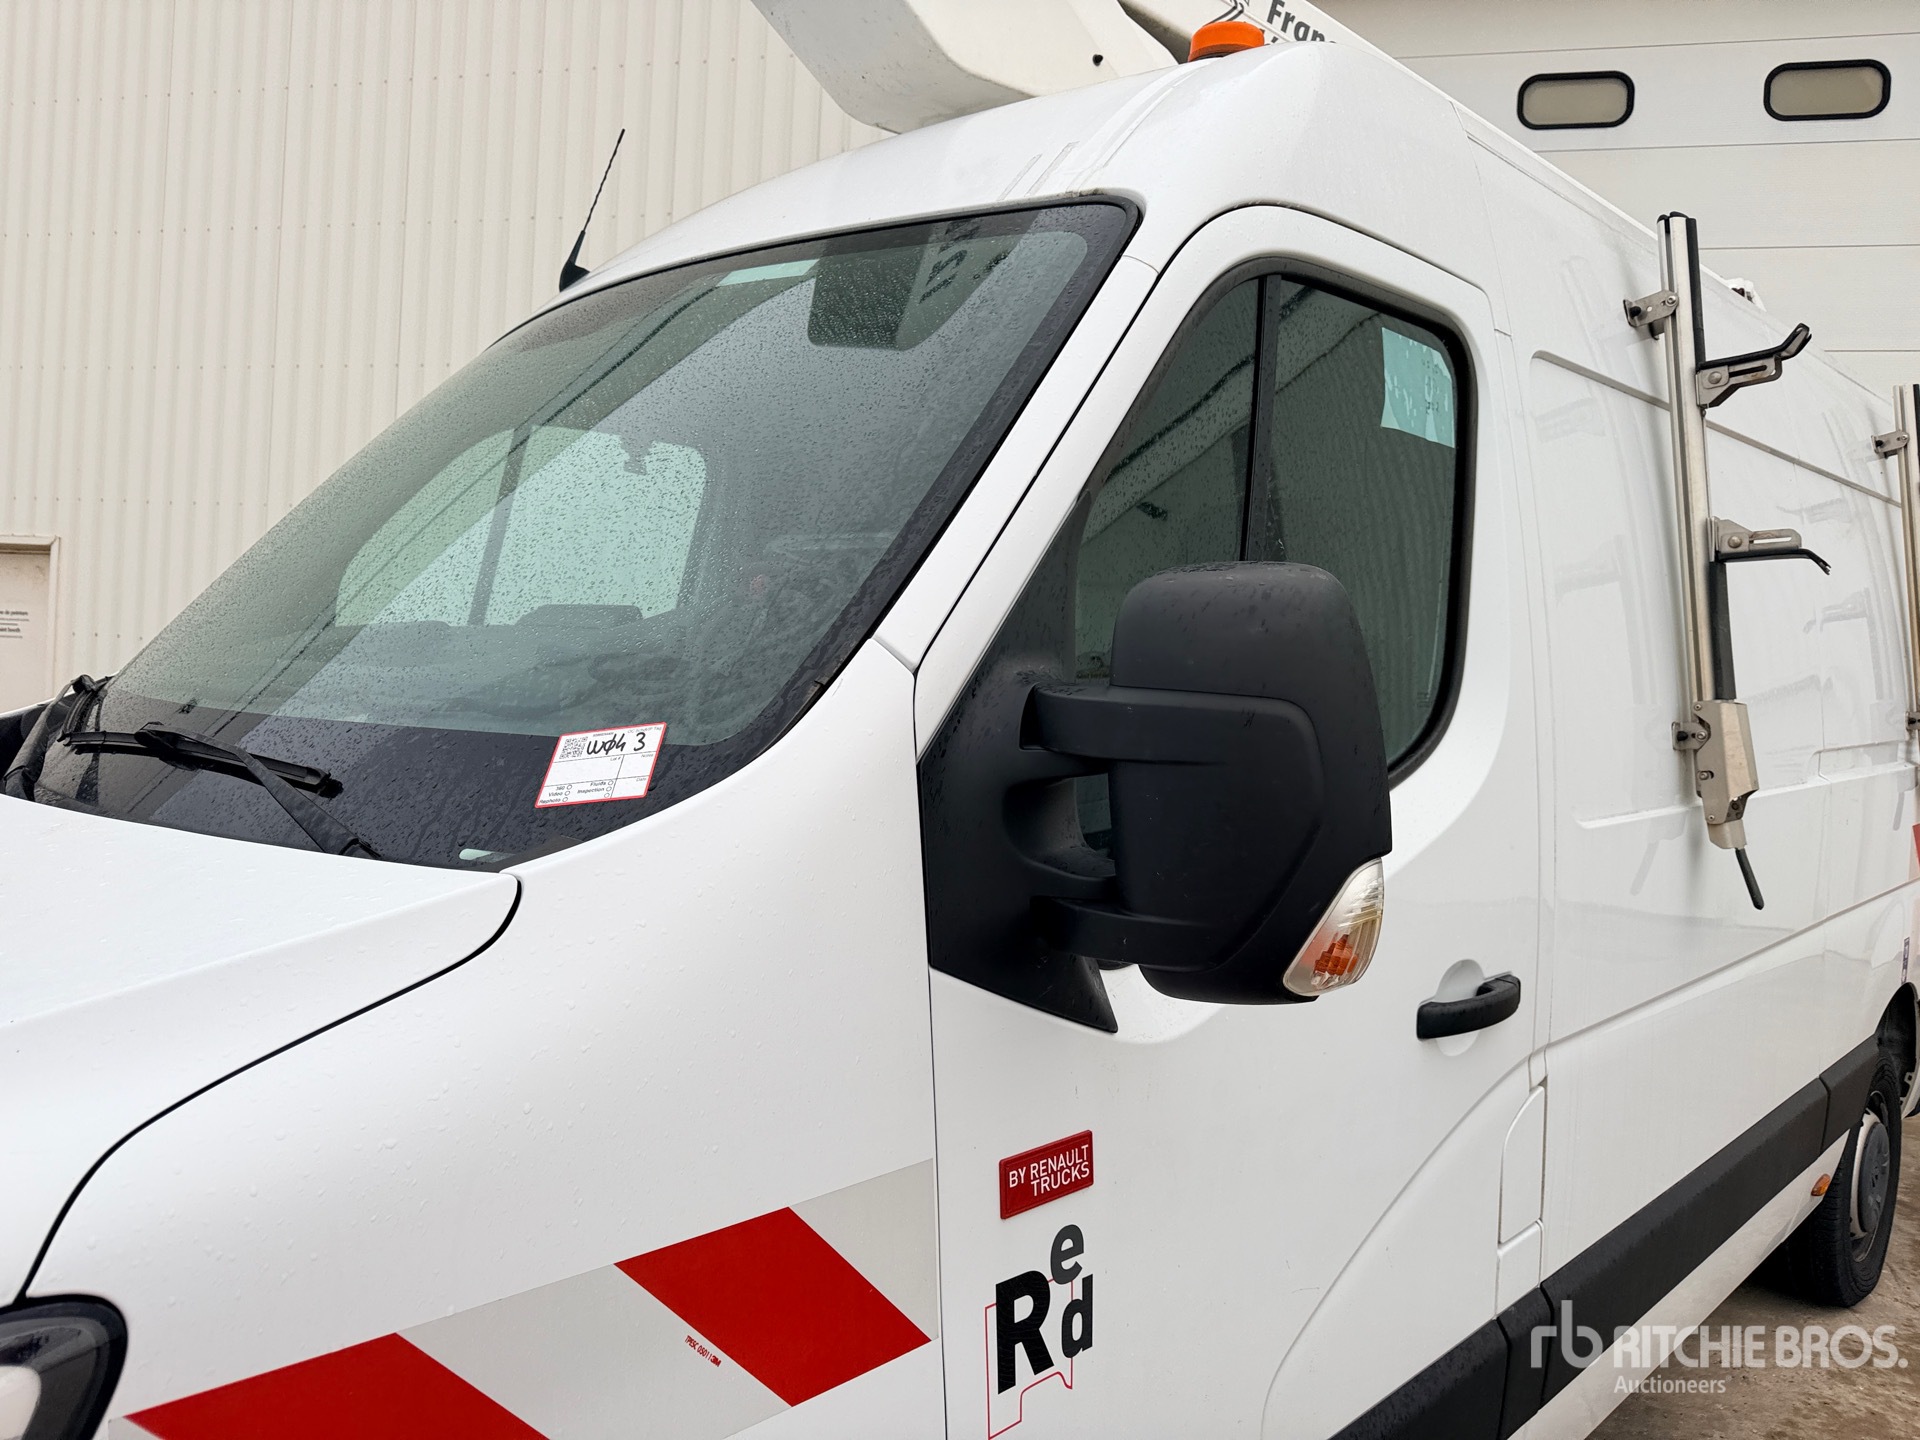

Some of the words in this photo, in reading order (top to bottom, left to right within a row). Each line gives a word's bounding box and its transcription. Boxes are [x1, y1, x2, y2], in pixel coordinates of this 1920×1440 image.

[1267, 0, 1336, 43] Fran
[1009, 1166, 1027, 1188] BY
[1030, 1144, 1089, 1180] RENAULT
[1030, 1161, 1090, 1197] TRUCKS
